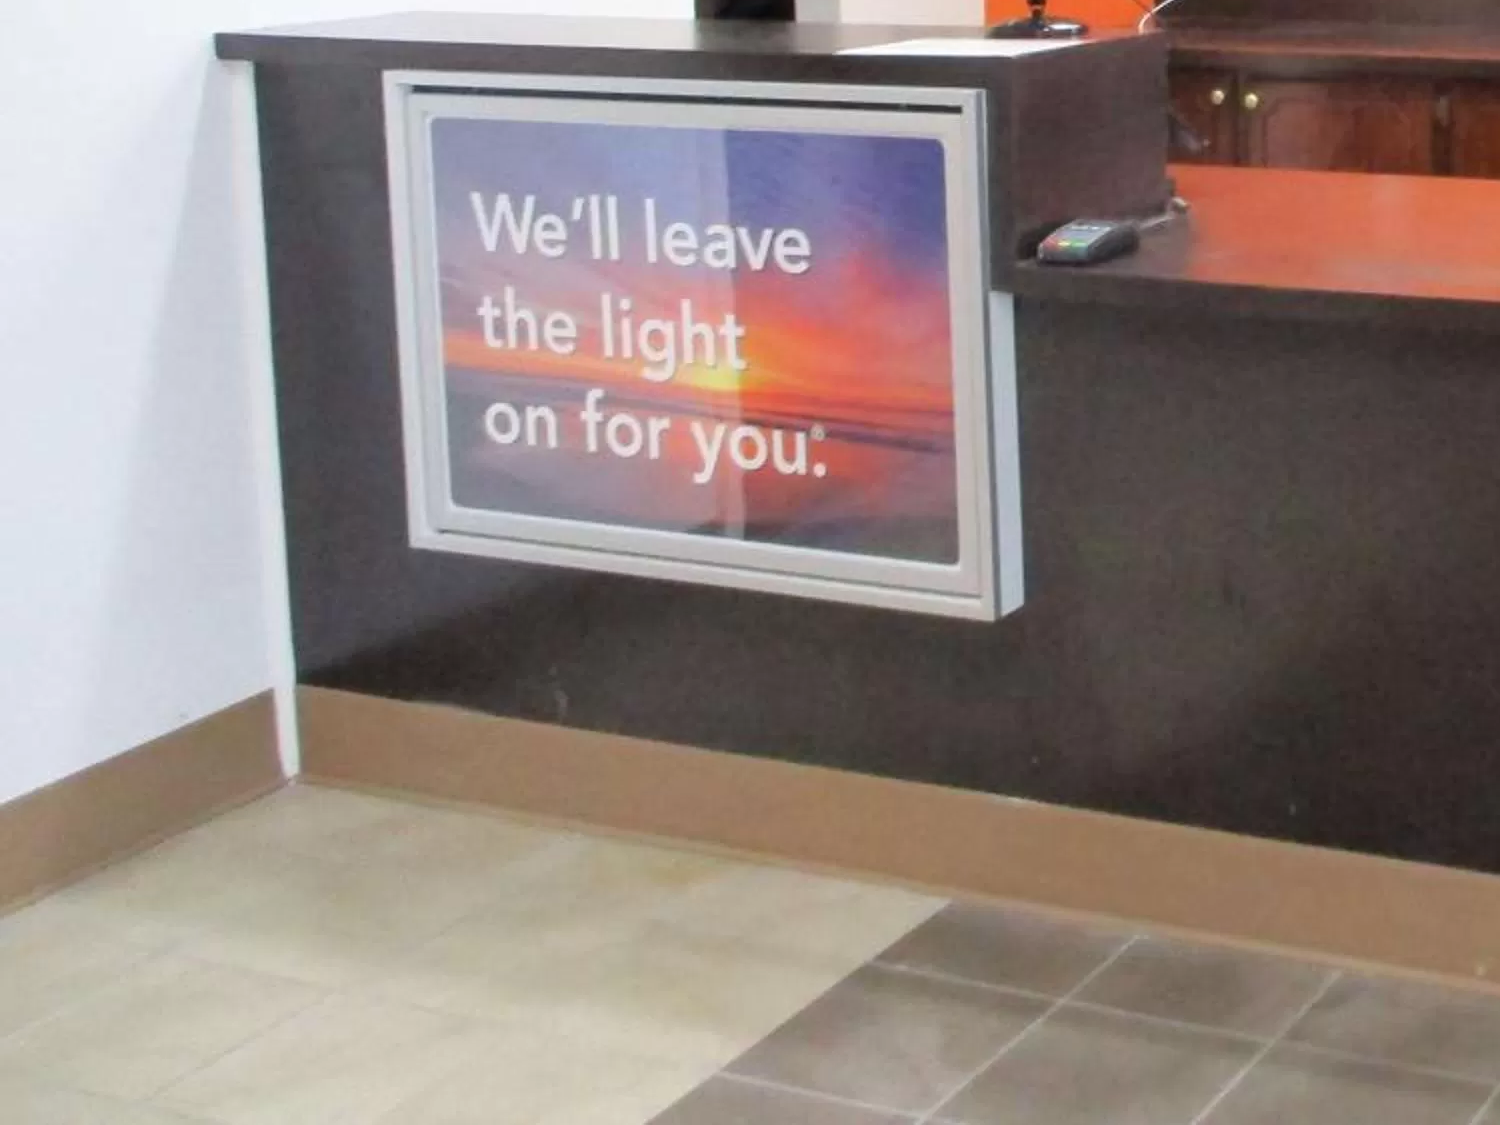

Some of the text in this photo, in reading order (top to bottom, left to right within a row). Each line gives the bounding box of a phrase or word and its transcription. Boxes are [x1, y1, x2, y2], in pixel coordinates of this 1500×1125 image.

[469, 191, 812, 275] We'll leave
[477, 286, 747, 382] the light
[484, 400, 558, 449] on
[580, 390, 671, 460] for
